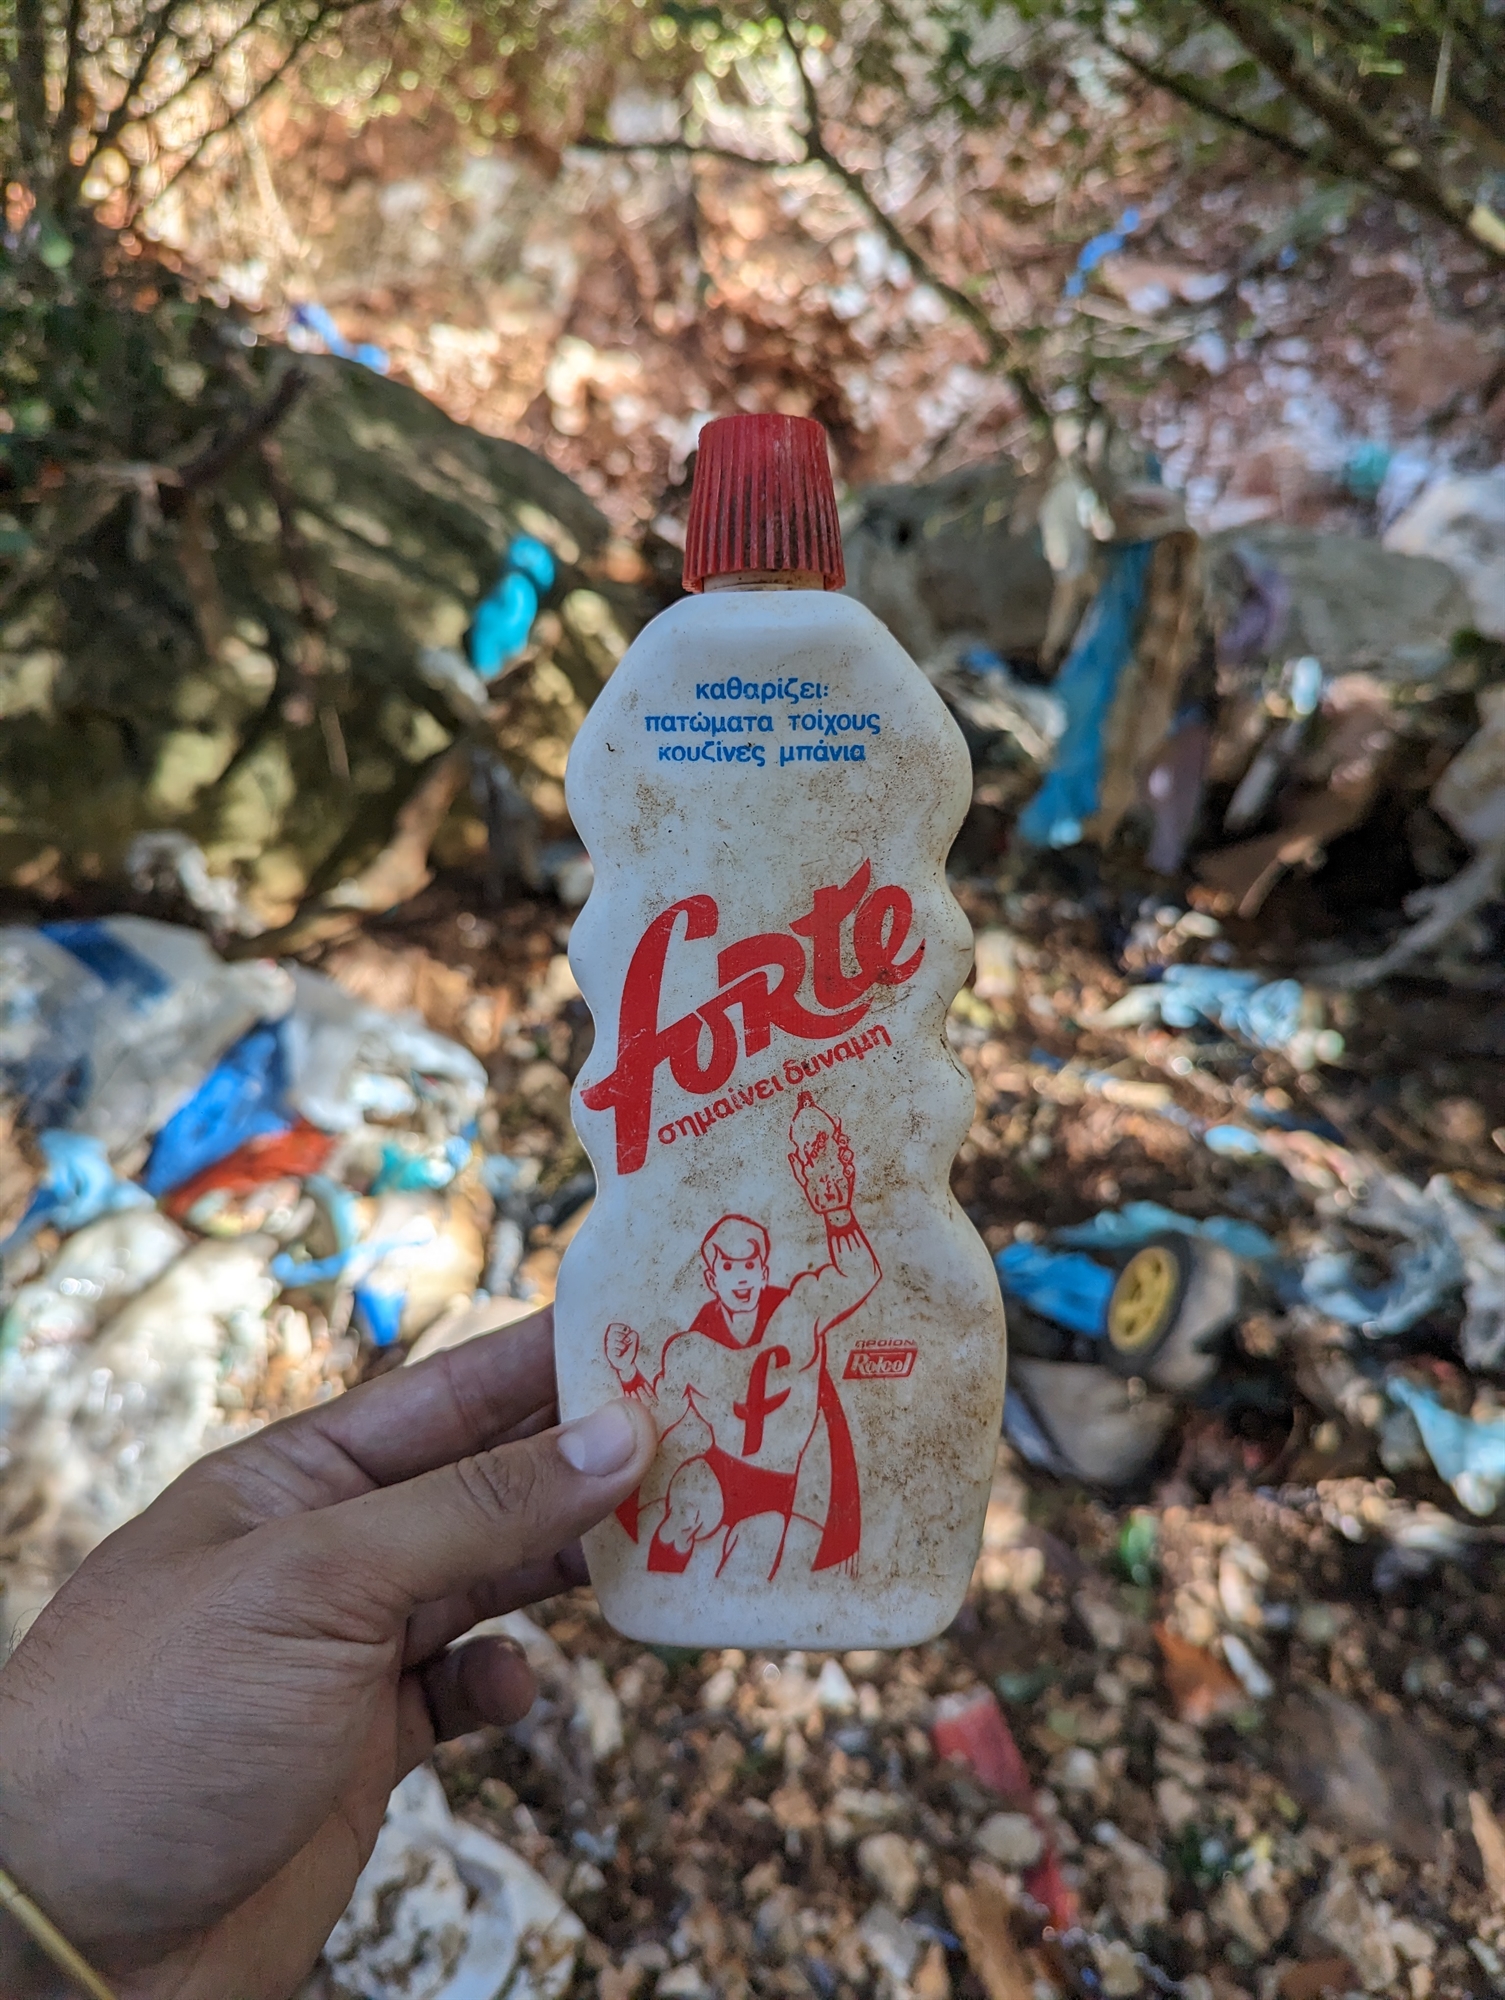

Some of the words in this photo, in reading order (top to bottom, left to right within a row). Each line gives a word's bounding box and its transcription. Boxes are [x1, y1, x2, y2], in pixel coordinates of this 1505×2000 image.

[696, 676, 829, 704] καθαρίζει:
[644, 711, 774, 737] πατώματα
[788, 709, 881, 735] τοίχους
[658, 740, 766, 767] κουζίνες
[780, 739, 867, 767] μπάνια
[657, 1076, 784, 1145] σημαίνει
